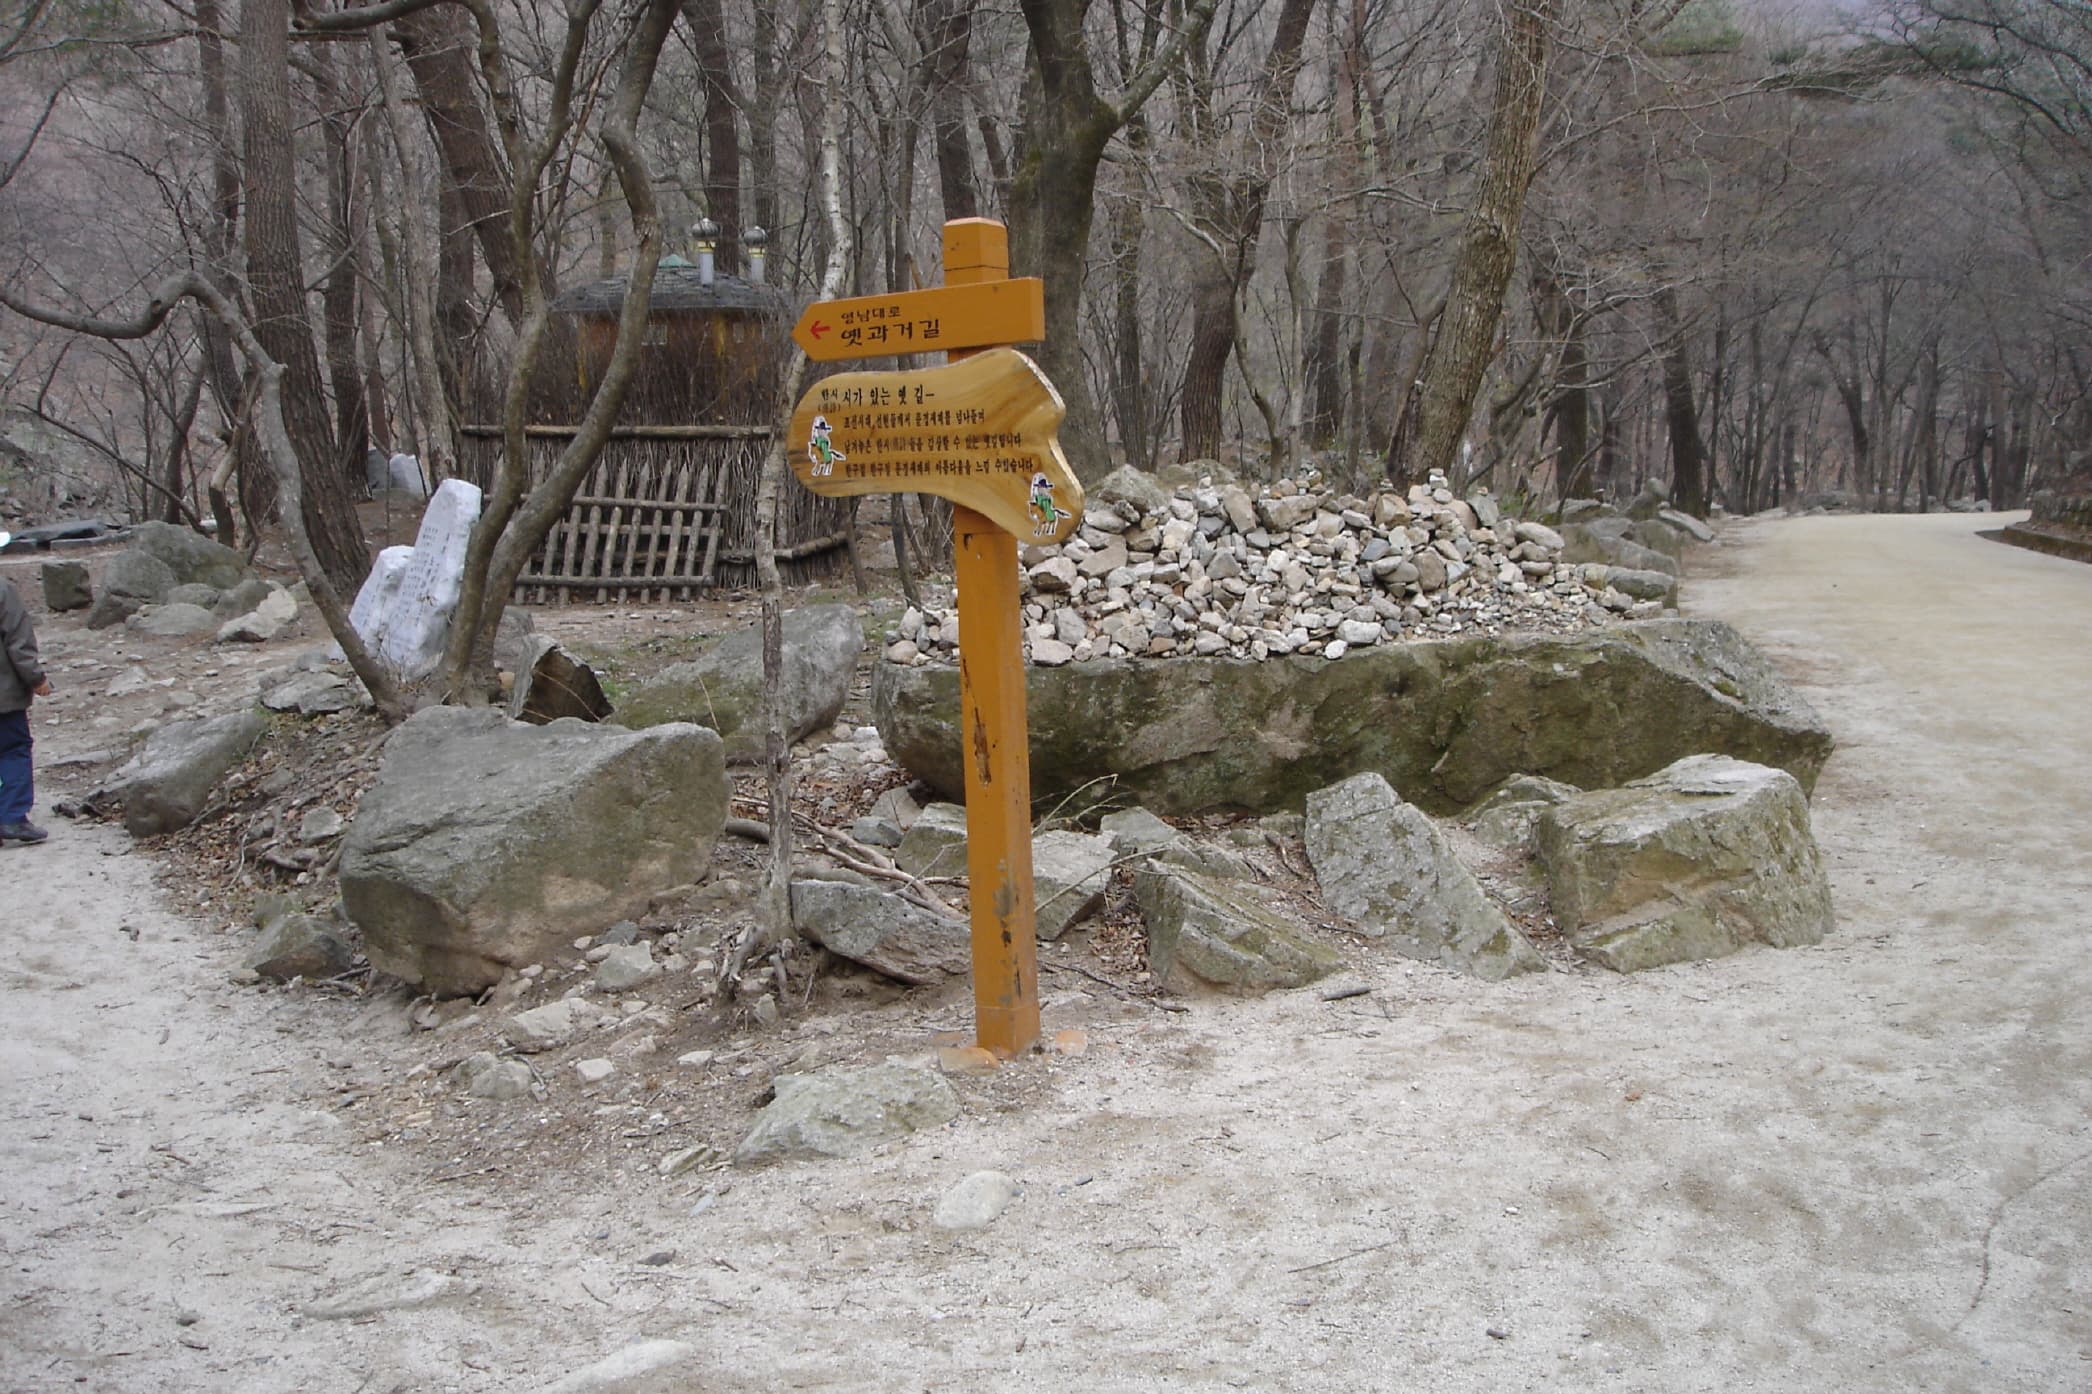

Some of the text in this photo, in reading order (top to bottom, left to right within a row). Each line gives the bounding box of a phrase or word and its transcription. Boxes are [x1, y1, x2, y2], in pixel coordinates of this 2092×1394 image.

[841, 305, 902, 324] 영남대로
[843, 387, 863, 407] 시가
[870, 386, 891, 406] 있는
[898, 384, 907, 405] 옛
[953, 434, 960, 450] 수
